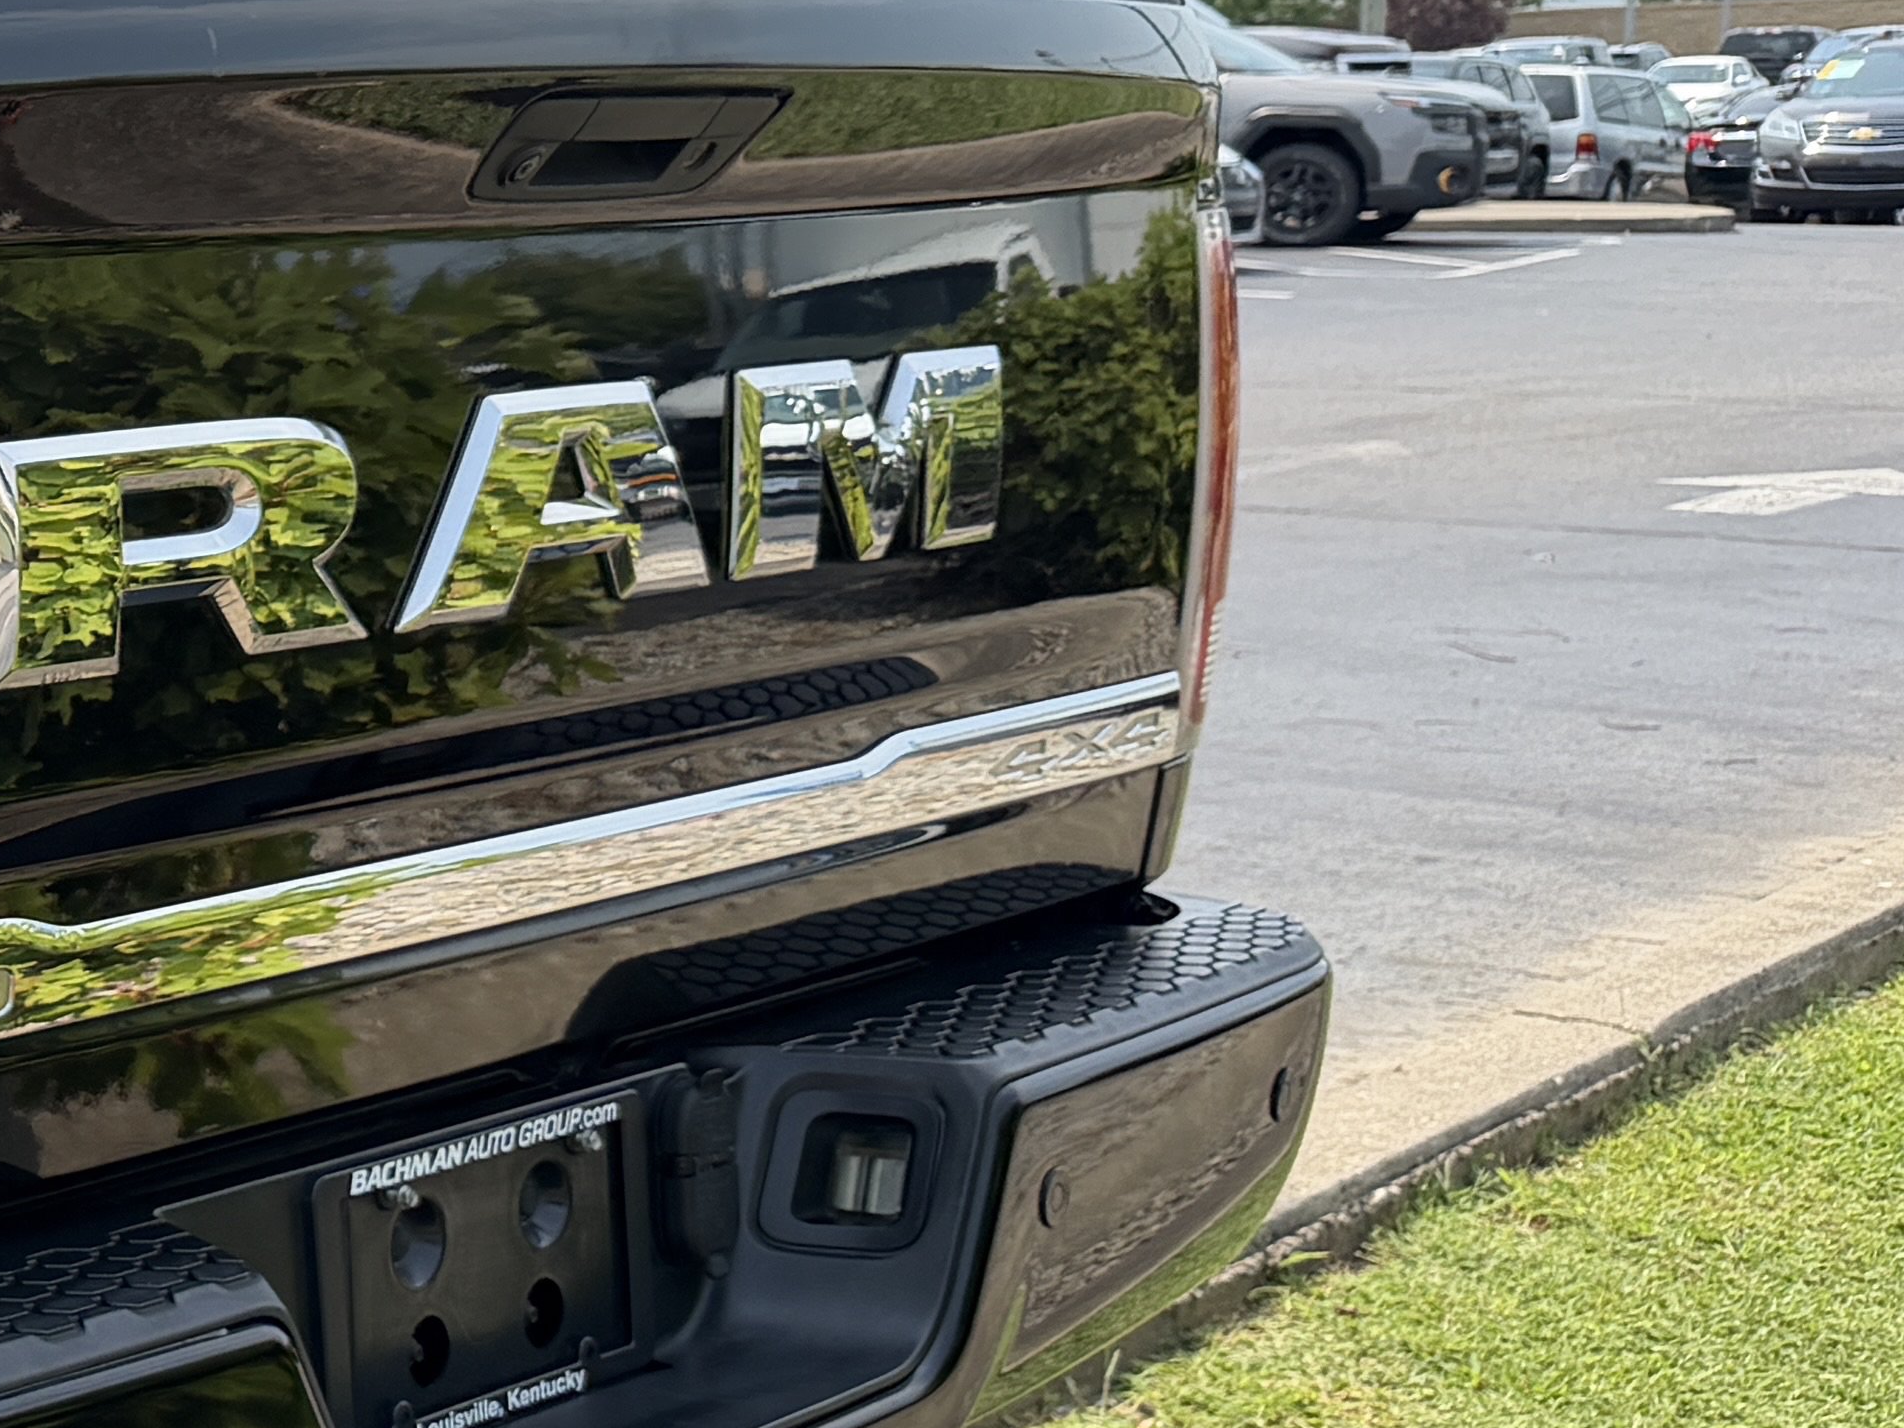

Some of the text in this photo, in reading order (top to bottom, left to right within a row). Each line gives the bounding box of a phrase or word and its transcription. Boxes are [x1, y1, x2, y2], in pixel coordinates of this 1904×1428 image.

[349, 1101, 620, 1197] BACHMAN AUTO GROUP.com
[506, 1369, 587, 1413] Kentucky
